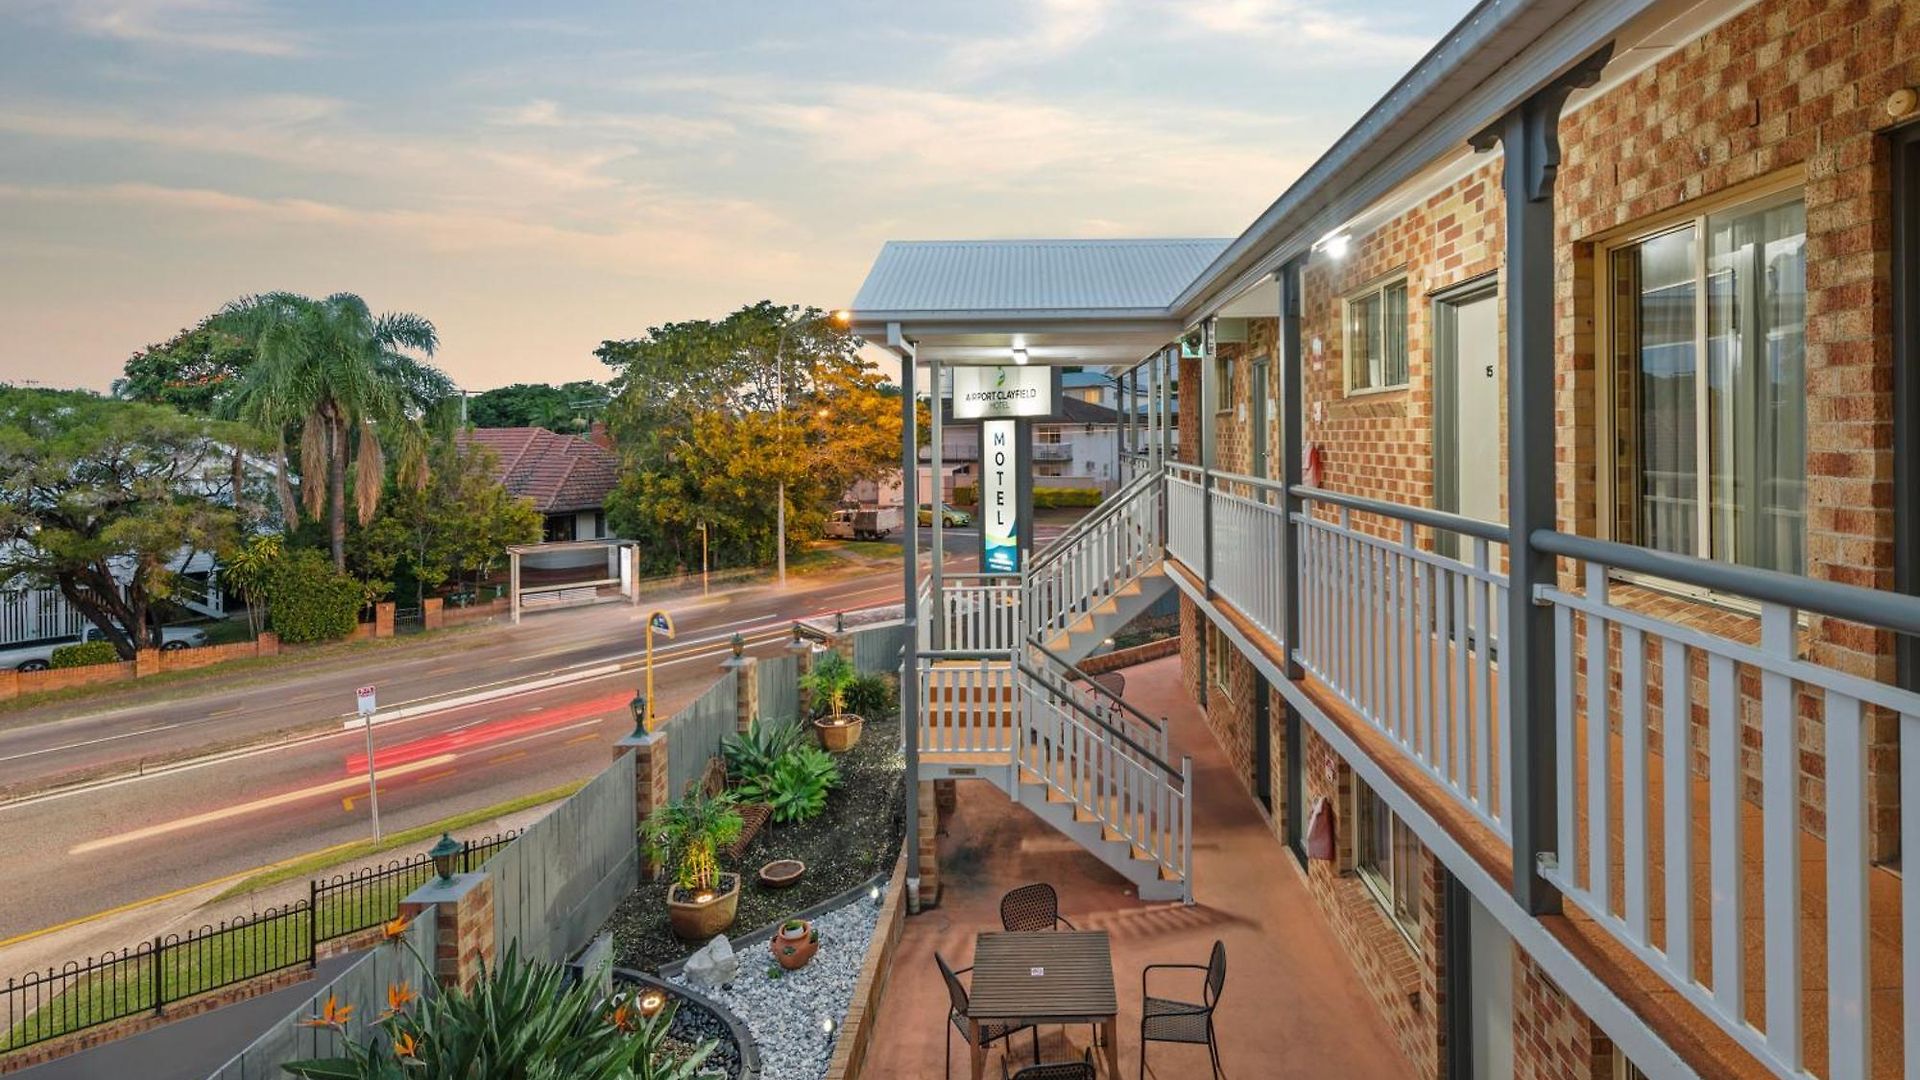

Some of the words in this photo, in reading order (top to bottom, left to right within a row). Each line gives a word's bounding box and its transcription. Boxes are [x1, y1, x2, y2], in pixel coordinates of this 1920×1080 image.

[966, 391, 996, 401] ARPORT
[997, 388, 1037, 400] CLAYFIELD
[994, 432, 1005, 525] MOTEL
